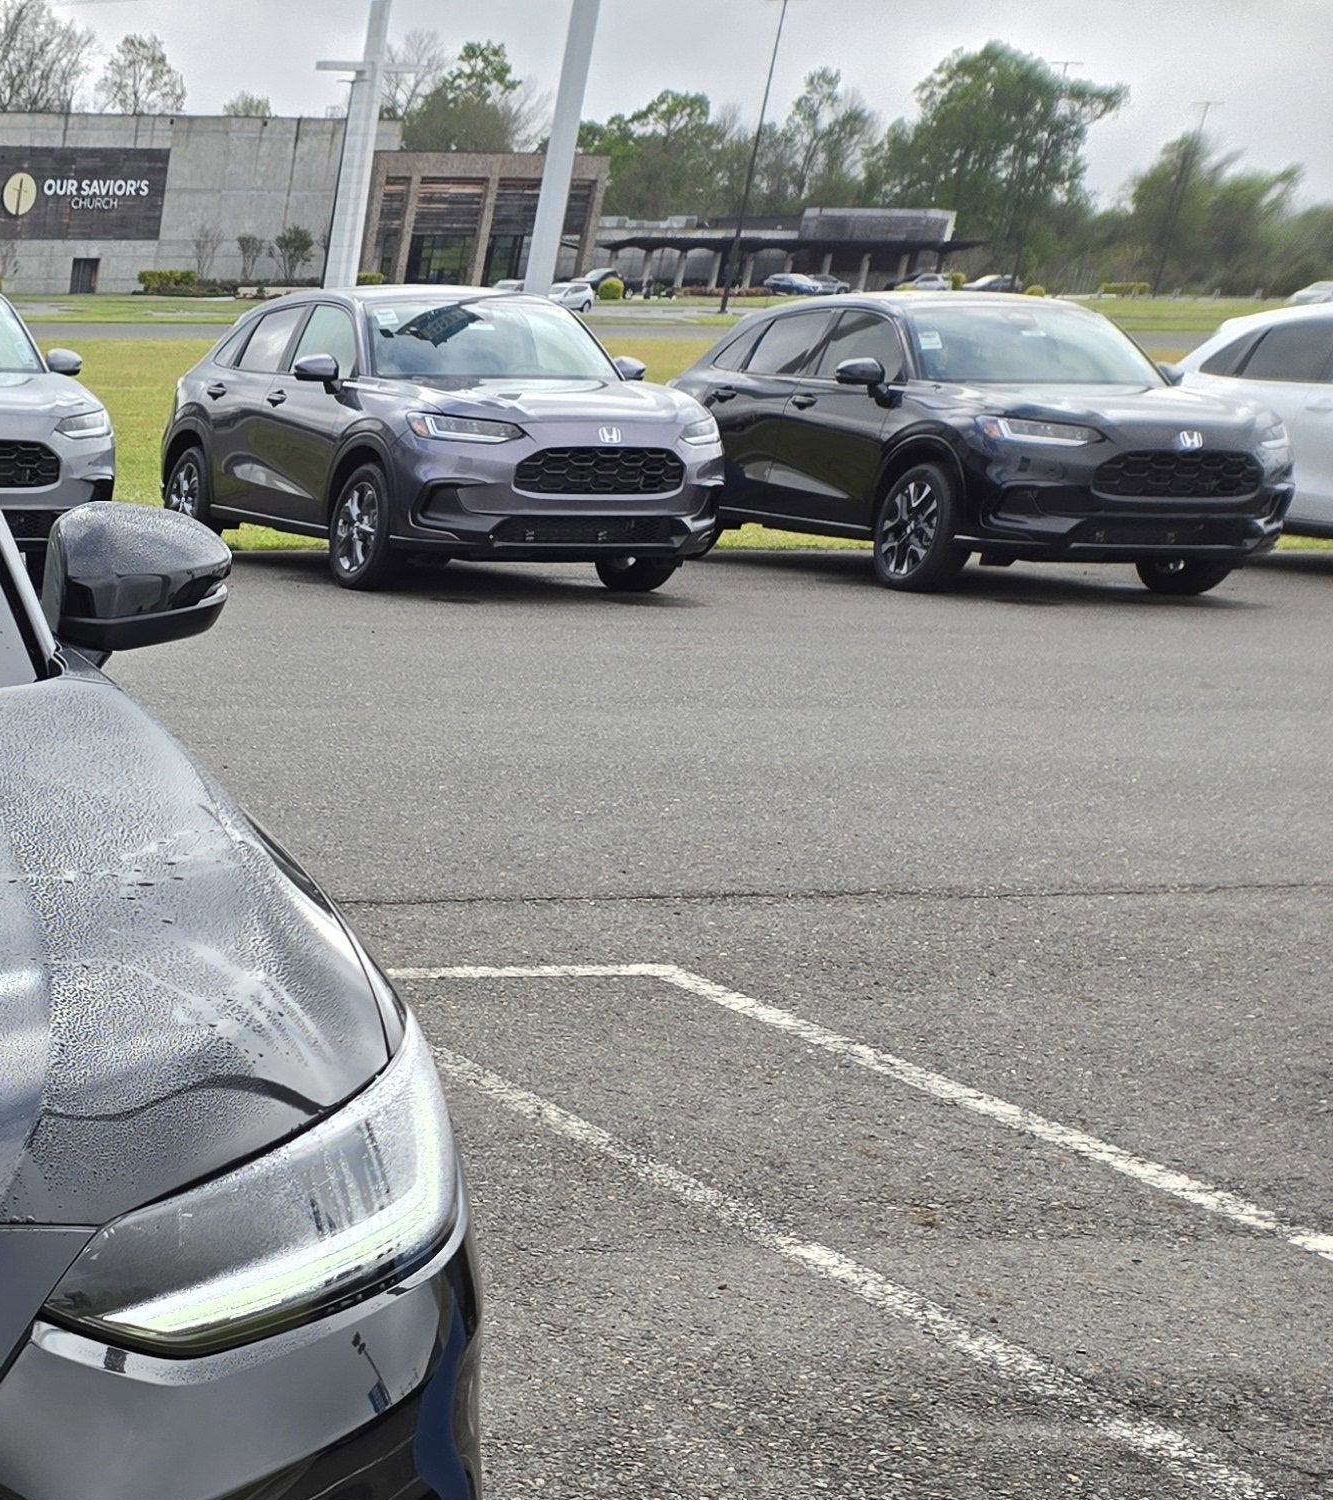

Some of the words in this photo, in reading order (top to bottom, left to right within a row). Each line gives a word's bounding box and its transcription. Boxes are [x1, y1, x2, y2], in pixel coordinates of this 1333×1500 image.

[43, 179, 78, 196] OUR
[80, 179, 150, 196] SAVIOR'S
[71, 197, 118, 210] CHURCH
